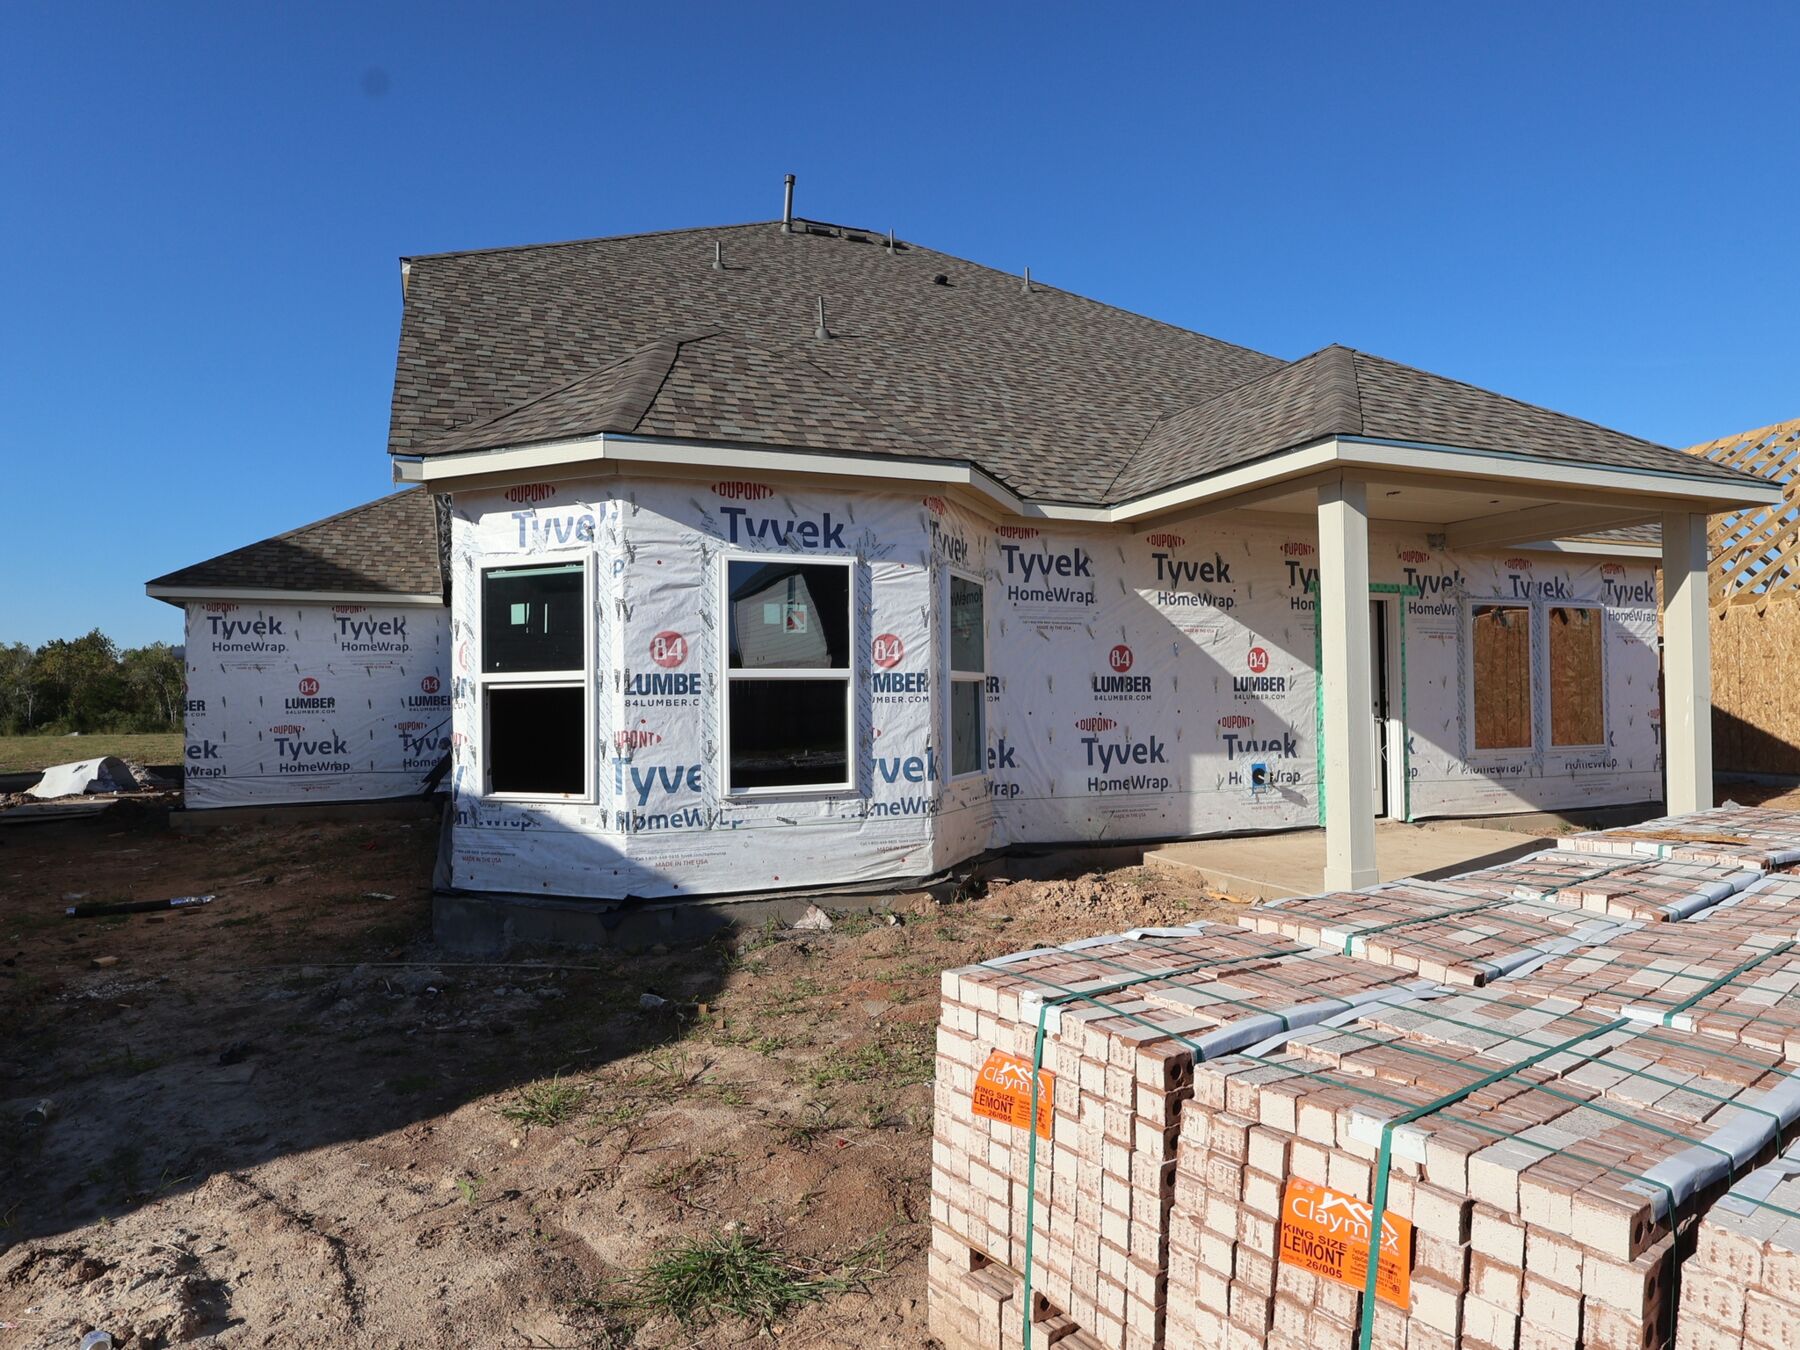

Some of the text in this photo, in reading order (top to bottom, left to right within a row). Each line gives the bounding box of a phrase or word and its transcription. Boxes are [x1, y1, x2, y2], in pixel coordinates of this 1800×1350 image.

[511, 484, 550, 502] DUPONT
[720, 481, 767, 500] DUPONT
[720, 507, 846, 549] Tyvek
[1000, 526, 1035, 539] DUPONT
[1151, 534, 1182, 548] DUPONT
[1284, 542, 1312, 556] DUPONT
[1001, 545, 1090, 583] Tyvek
[1402, 551, 1427, 563] DUPONT
[1507, 558, 1529, 571] DUPONT
[1152, 552, 1231, 589] Tyvek
[1008, 585, 1094, 606] HomeWrap
[1158, 592, 1234, 610] HomeWrap
[1604, 579, 1653, 607] Tyvek
[206, 603, 236, 612] DUPONT
[335, 605, 362, 614] DUPONT
[1608, 609, 1656, 622] HomeWrap
[207, 616, 282, 640] Tyvek
[336, 617, 406, 640] Tyvek
[212, 642, 285, 653] HomeWrap
[341, 642, 409, 653] HomeWrap
[654, 638, 683, 661] 84
[873, 640, 900, 660] 84
[1111, 650, 1130, 667] 84
[1249, 652, 1266, 668] 84
[301, 681, 317, 692] 84
[424, 680, 437, 690] 84
[1094, 676, 1151, 692] LUMBER
[1233, 676, 1285, 692] LUMBER
[285, 698, 335, 709] LUMBER
[273, 725, 301, 734] DUPONT
[398, 721, 424, 730] DUPONT
[1080, 718, 1112, 732] DUPONT
[1222, 715, 1251, 728] DUPONT
[274, 735, 347, 761] Tyvek
[1081, 735, 1165, 774] Tyvek
[280, 762, 350, 772] HomeWrap
[1088, 775, 1169, 791] HomeWrap
[984, 1066, 1047, 1100] Claymx
[975, 1085, 1015, 1104] KING SIZE
[974, 1092, 1013, 1114] LEMONT
[1283, 1222, 1314, 1240] KING
[1318, 1235, 1347, 1252] SIZE
[1283, 1232, 1345, 1268] LEMONT
[1306, 1259, 1342, 1279] 26/005
